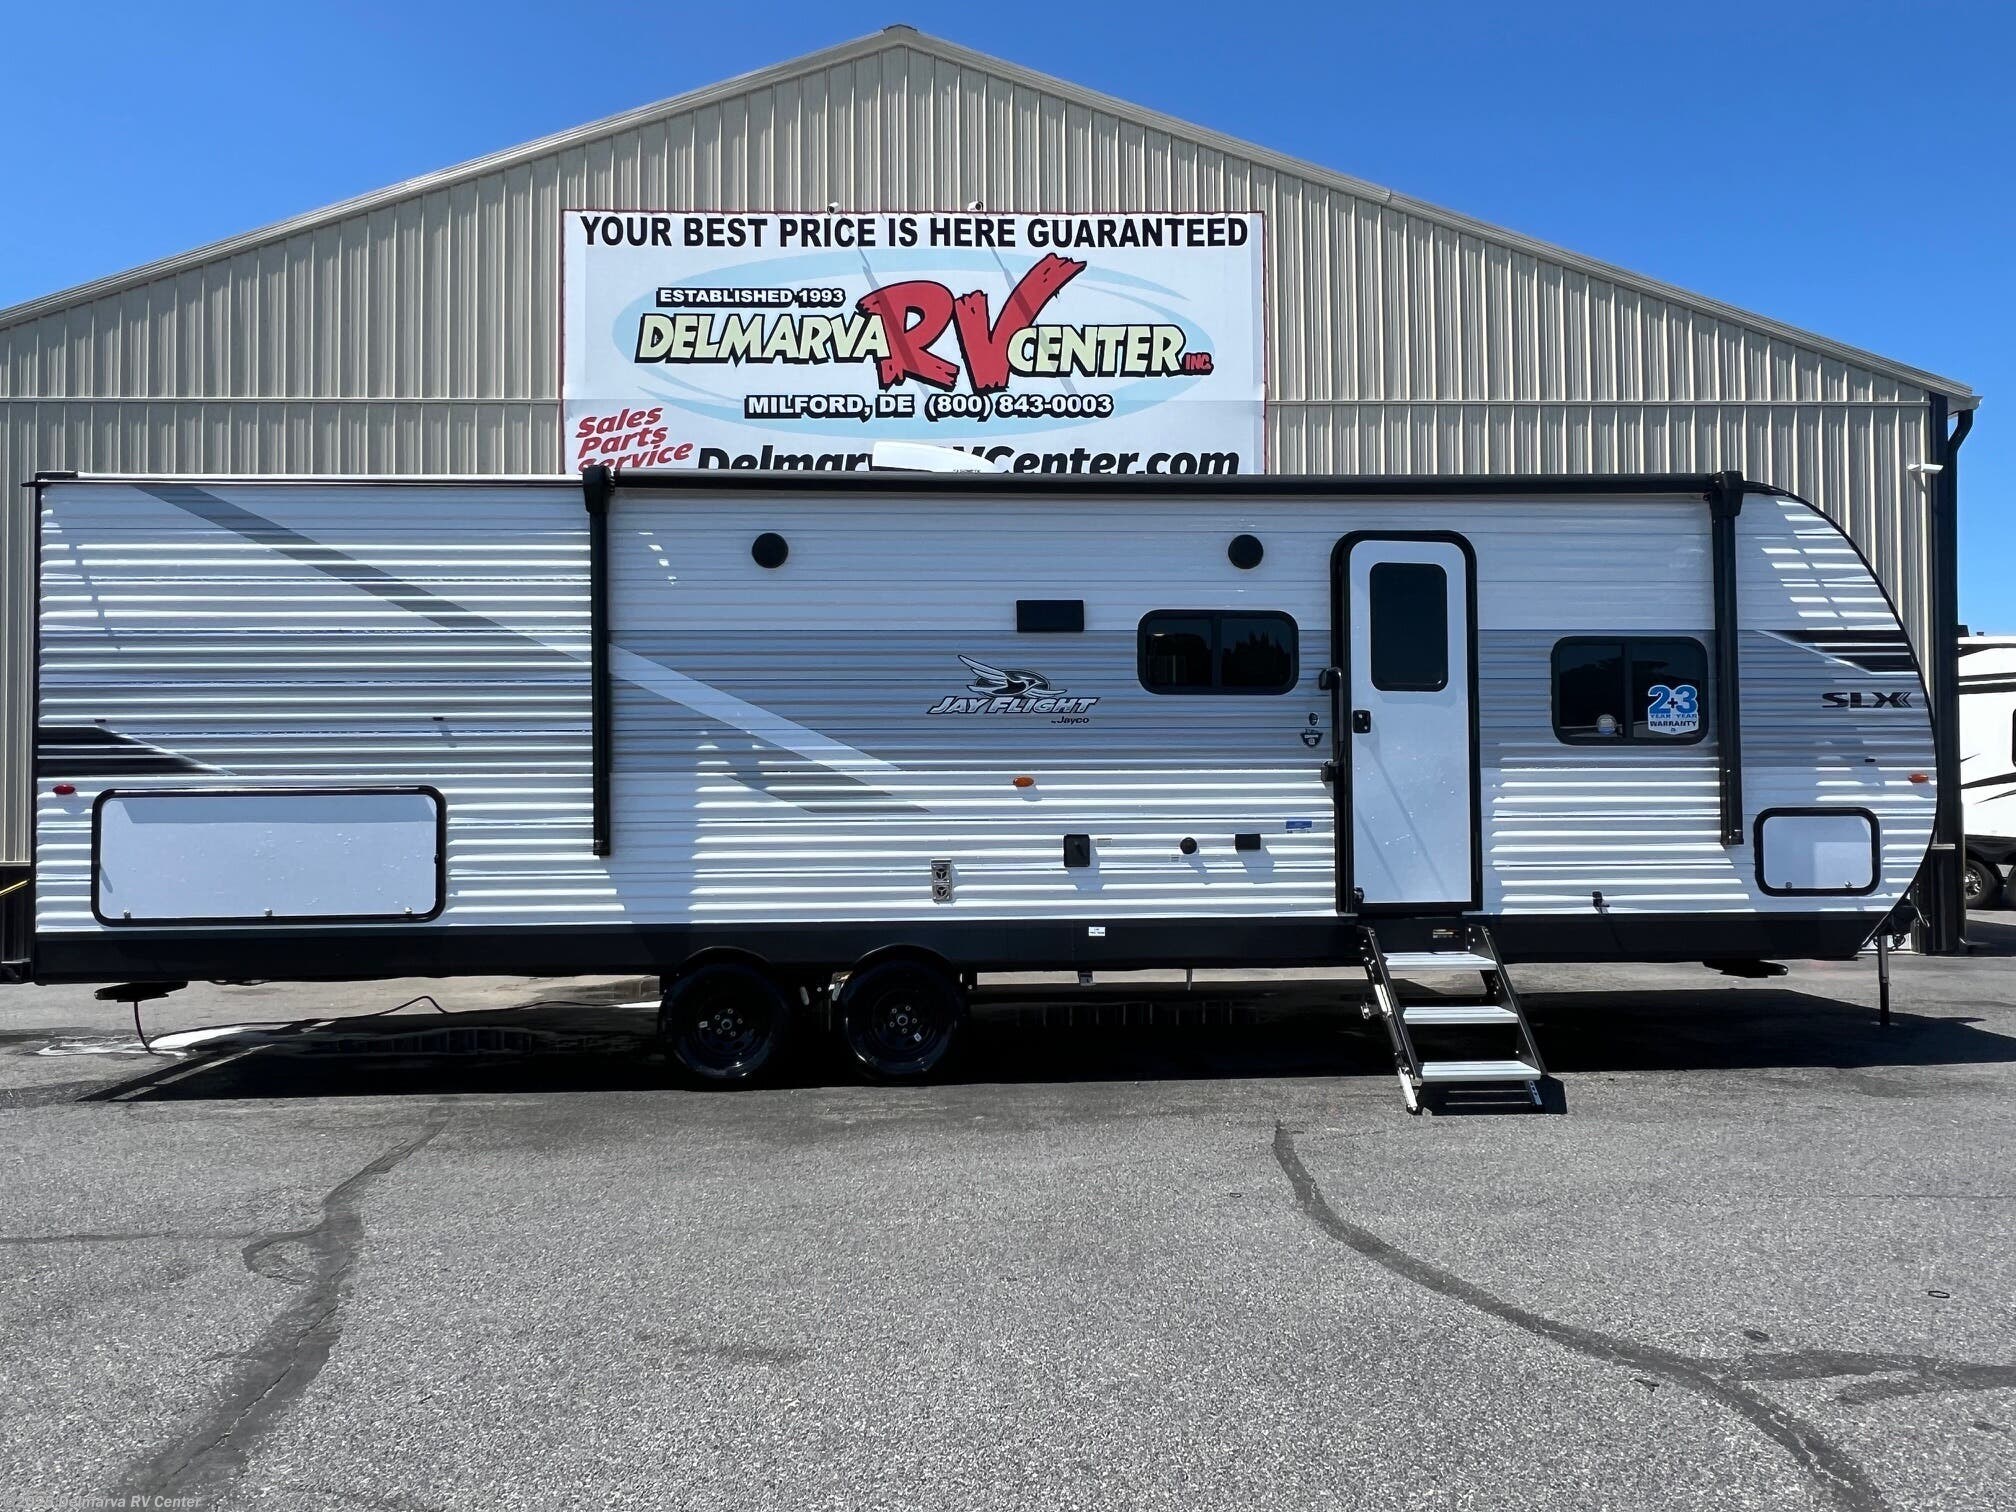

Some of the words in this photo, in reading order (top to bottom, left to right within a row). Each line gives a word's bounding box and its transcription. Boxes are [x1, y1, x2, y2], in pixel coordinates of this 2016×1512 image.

[580, 216, 671, 246] YOUR
[684, 217, 767, 247] BEST
[780, 218, 876, 247] PRICE
[888, 218, 918, 247] IS
[930, 218, 1016, 247] HERE
[1027, 217, 1248, 247] GUARANTEED
[659, 288, 793, 304] ESTABLISHED
[798, 288, 844, 304] 1993
[636, 313, 891, 363] DELMARVA
[857, 253, 1087, 392] RV
[1007, 325, 1186, 375] CENTER
[747, 395, 871, 421] MILFORD,
[878, 395, 914, 416] DE
[927, 394, 991, 421] (800)
[998, 395, 1113, 416] 843-0003
[576, 407, 663, 438] Sales
[578, 427, 668, 459] Parts
[927, 696, 990, 714] JAY
[986, 696, 1100, 714] FLIGHT
[1822, 692, 1911, 708] SLX
[1057, 716, 1089, 724] Jayco
